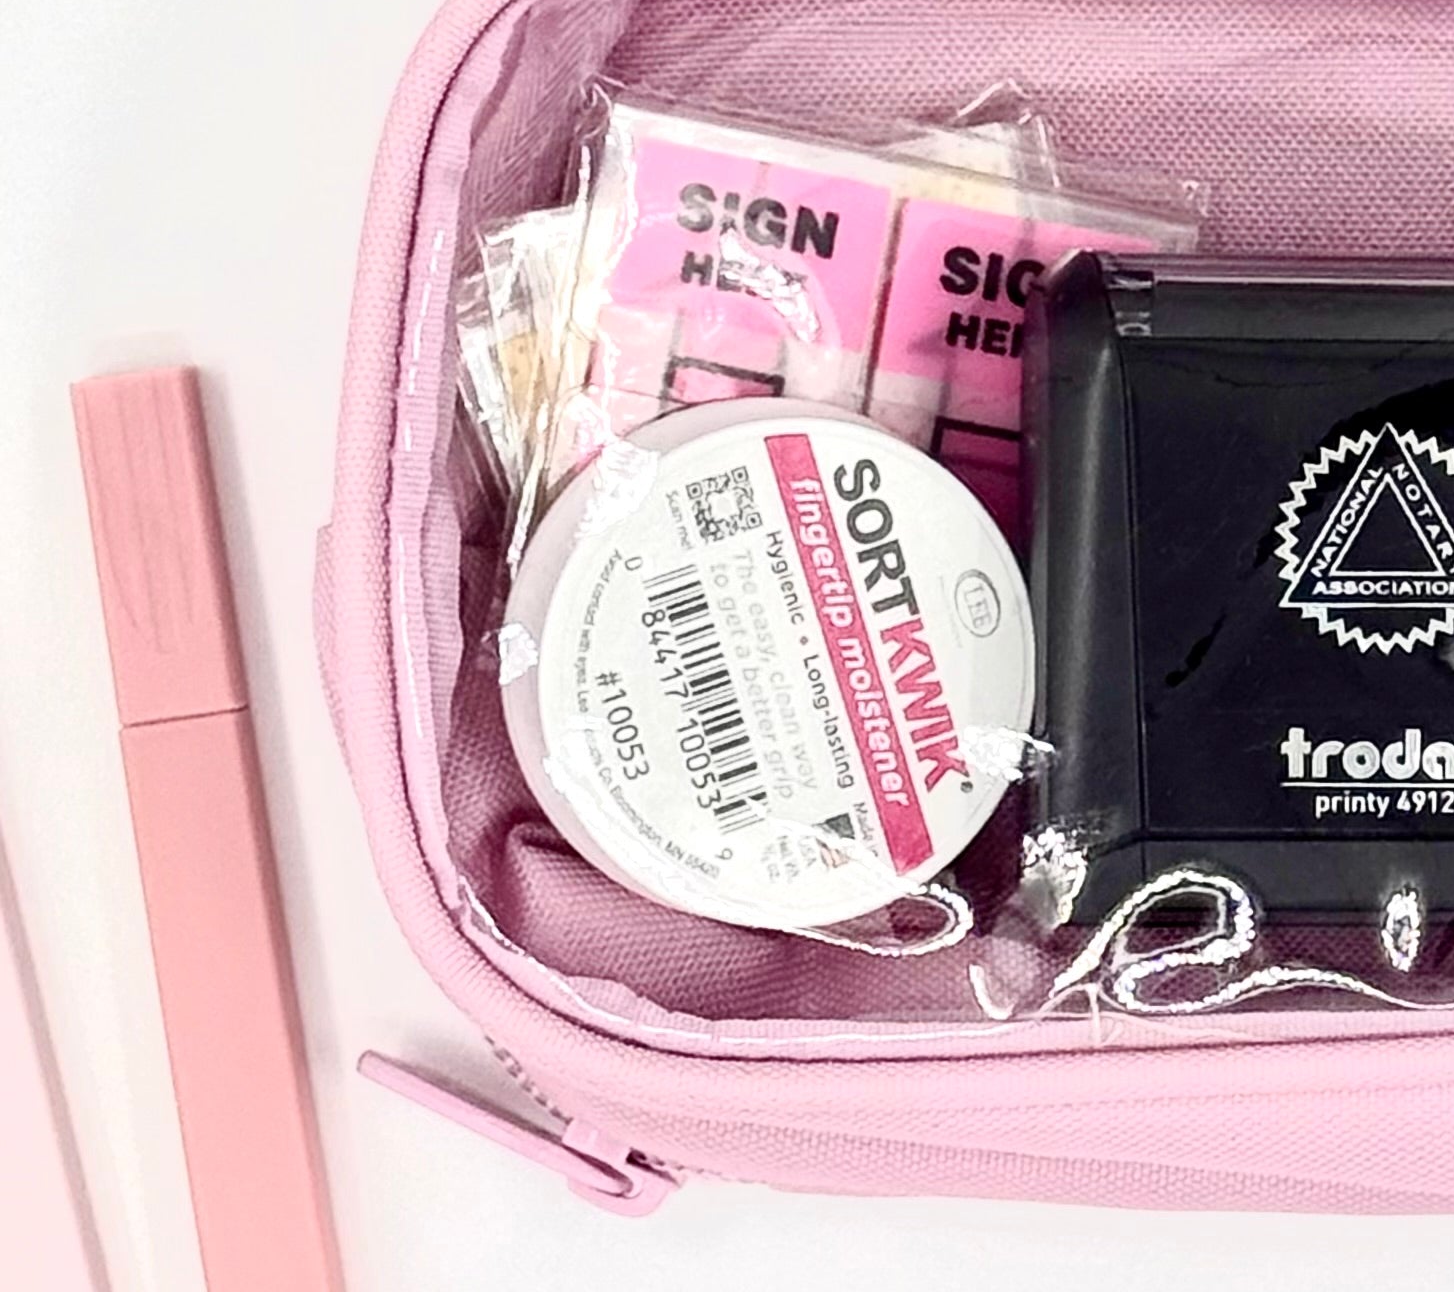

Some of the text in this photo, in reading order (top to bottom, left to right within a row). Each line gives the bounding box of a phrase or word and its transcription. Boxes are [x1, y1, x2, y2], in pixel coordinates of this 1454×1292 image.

[676, 183, 840, 259] SIGN
[679, 250, 808, 300] HE
[939, 246, 1046, 308] SIG
[945, 311, 1024, 358] HE
[1311, 466, 1384, 577] NATIONAL
[765, 529, 855, 789] Hygienic Long-lasting
[789, 477, 909, 805] fingertip moistener
[594, 670, 650, 781] #10053
[641, 609, 691, 699] 84417
[675, 716, 722, 809] 10053
[714, 846, 734, 861] 9
[740, 665, 777, 743] better
[1315, 791, 1390, 819] printy
